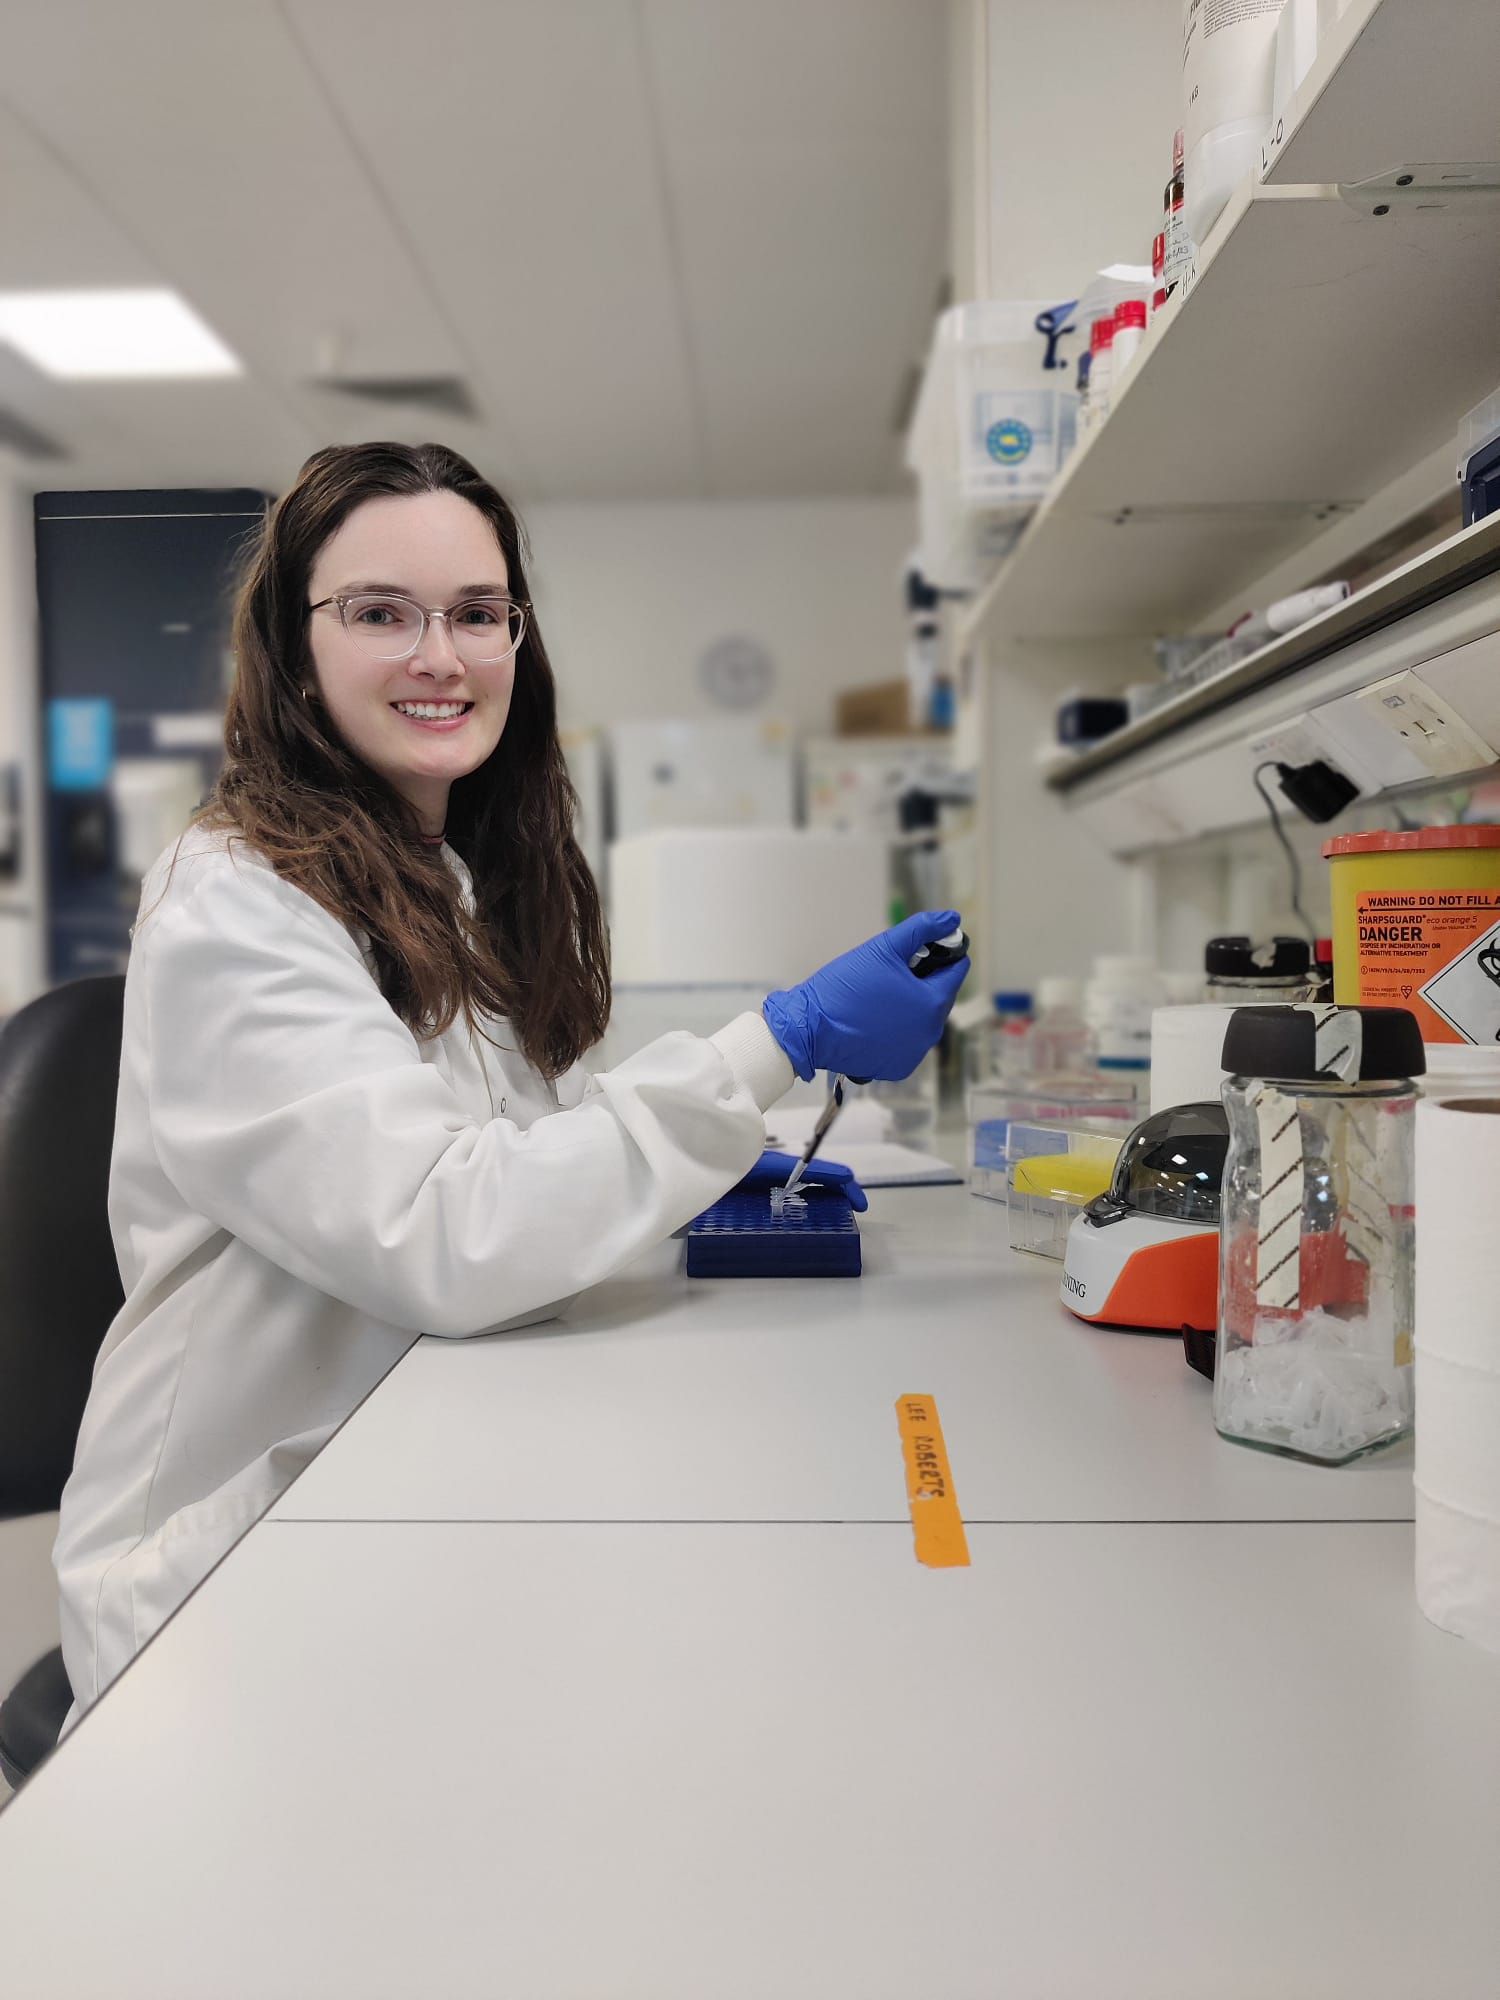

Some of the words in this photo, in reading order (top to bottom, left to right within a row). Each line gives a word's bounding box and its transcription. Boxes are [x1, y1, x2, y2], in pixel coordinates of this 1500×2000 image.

[1368, 896, 1416, 907] WARNING
[1419, 896, 1435, 906] DO
[1438, 895, 1463, 906] NOT
[1466, 895, 1491, 905] FILL
[1441, 916, 1471, 925] orange
[1359, 926, 1423, 941] DANGER
[1360, 949, 1391, 957] ALTERNATIVE
[905, 1402, 928, 1422] LEE
[914, 1436, 945, 1499] ROBERTS
